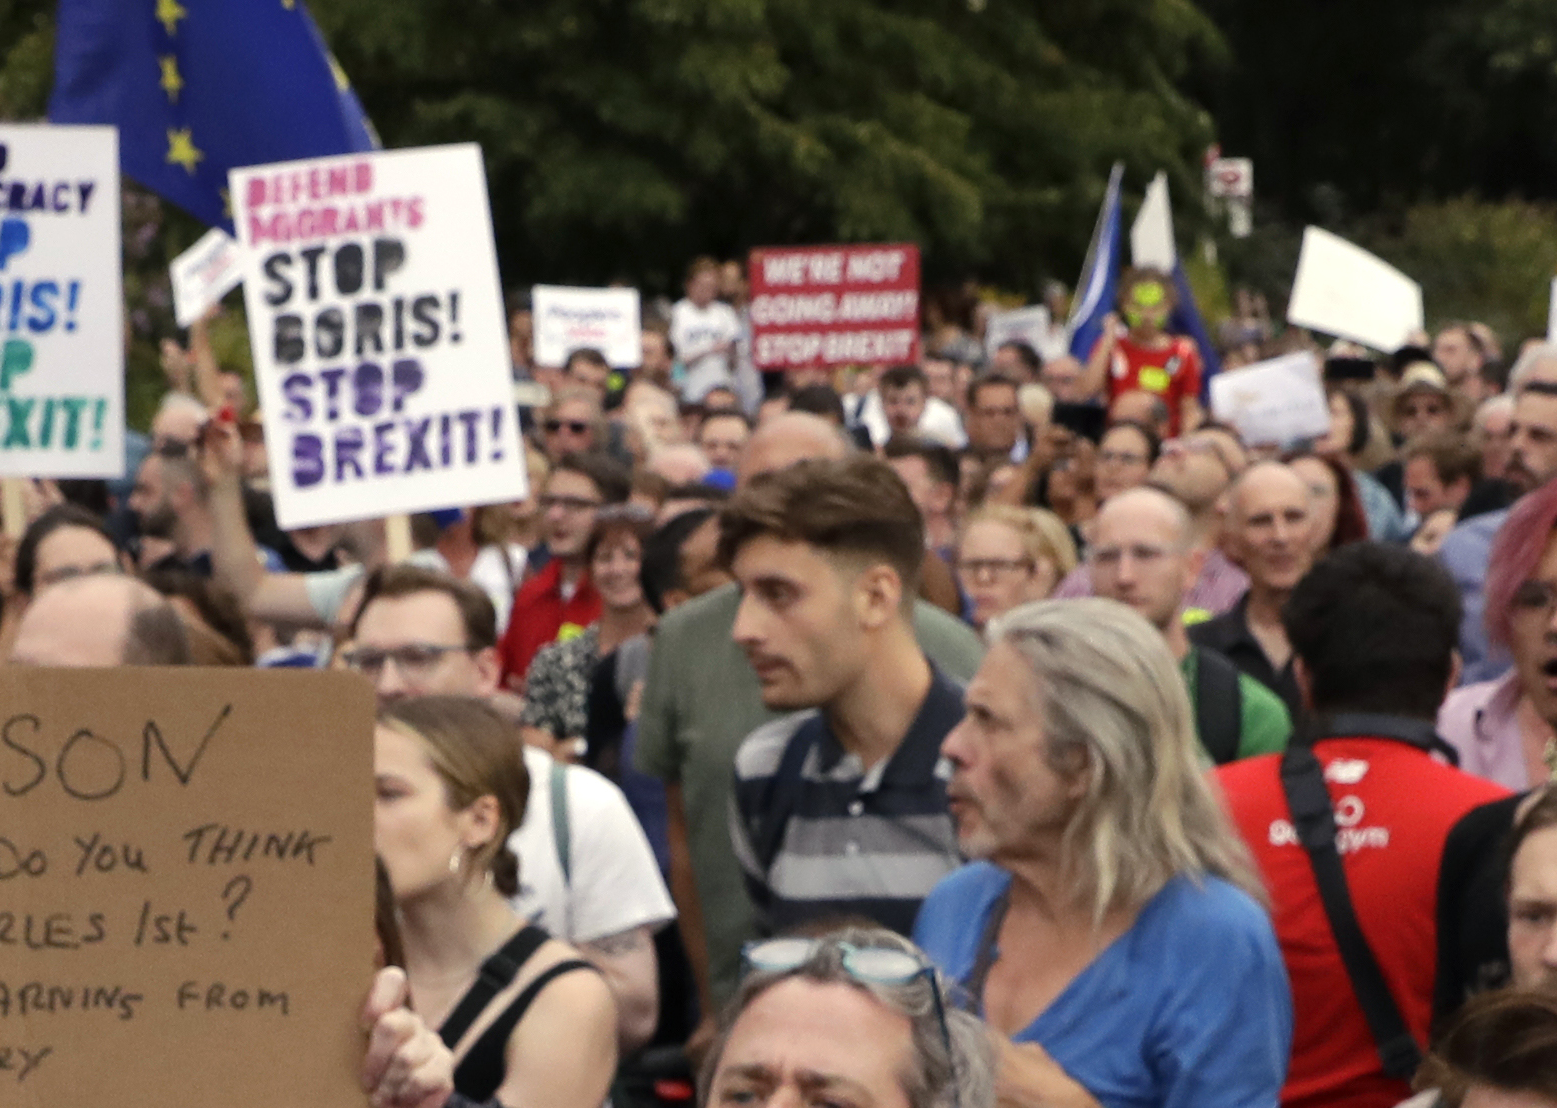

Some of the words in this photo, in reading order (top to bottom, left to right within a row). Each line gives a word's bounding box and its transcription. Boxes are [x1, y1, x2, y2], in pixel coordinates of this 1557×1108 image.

[247, 162, 372, 209] DEFEND
[248, 195, 425, 249] MIGRANTS
[262, 238, 407, 306] STOP
[273, 291, 463, 364] BORIS!
[281, 359, 425, 421] STOP
[291, 406, 504, 488] BREXIT!
[182, 822, 333, 867] THINK
